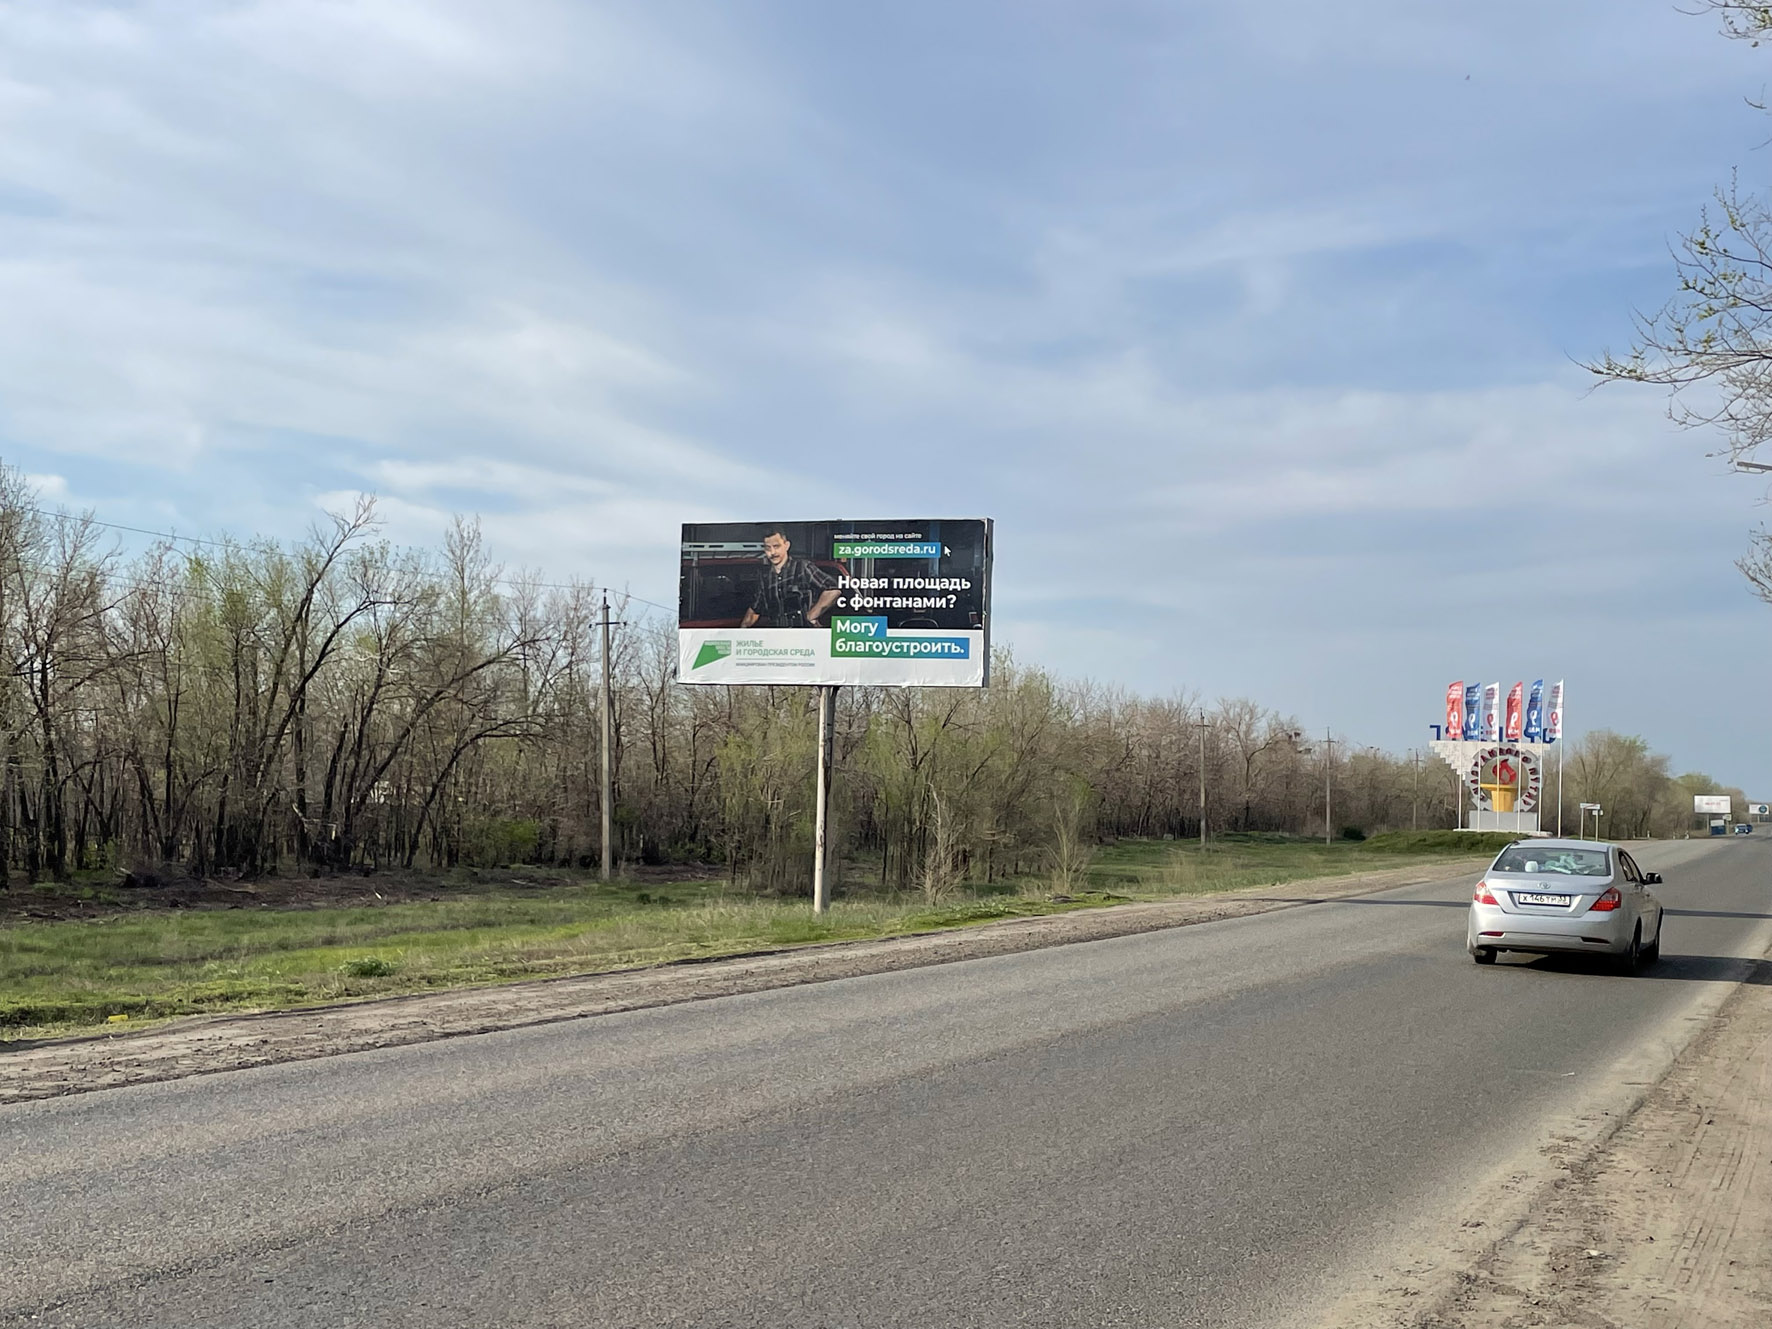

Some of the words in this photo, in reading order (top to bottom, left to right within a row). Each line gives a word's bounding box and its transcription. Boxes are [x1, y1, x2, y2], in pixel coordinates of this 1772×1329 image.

[838, 544, 936, 556] za.gorodsreda.ru
[838, 575, 888, 589] Новая
[893, 578, 971, 591] площадь
[836, 596, 847, 608] с
[850, 594, 957, 610] фонтанами?
[836, 620, 879, 637] Могу
[743, 649, 788, 657] ГОРОДСКАЯ
[789, 649, 816, 657] СРЕДА
[835, 638, 965, 656] благоустроить.
